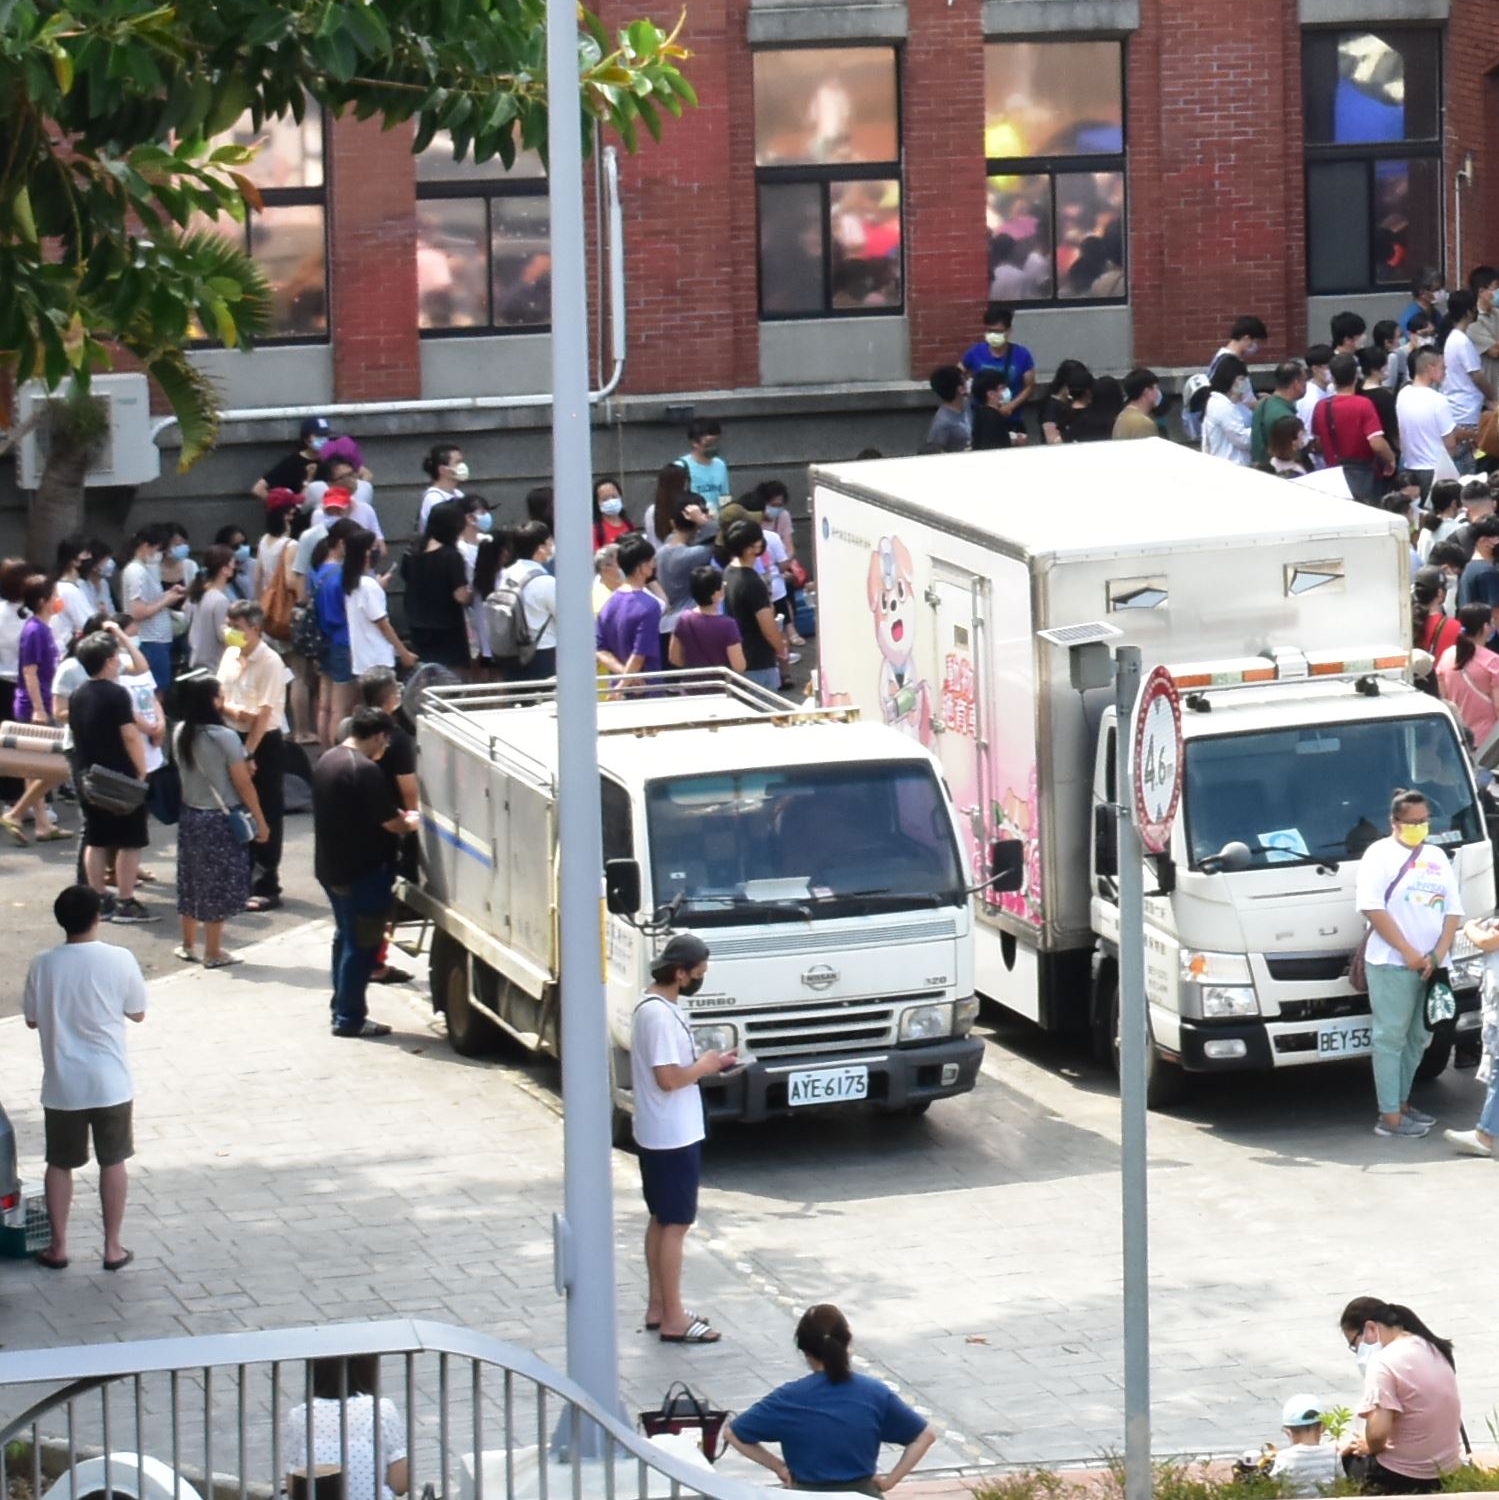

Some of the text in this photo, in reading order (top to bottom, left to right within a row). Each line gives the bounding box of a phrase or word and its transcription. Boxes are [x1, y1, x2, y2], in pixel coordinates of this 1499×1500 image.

[804, 972, 839, 982] NISSAN
[687, 997, 737, 1007] TURBO
[1320, 1029, 1372, 1052] BEY-53
[791, 1075, 866, 1101] AYE-6173
